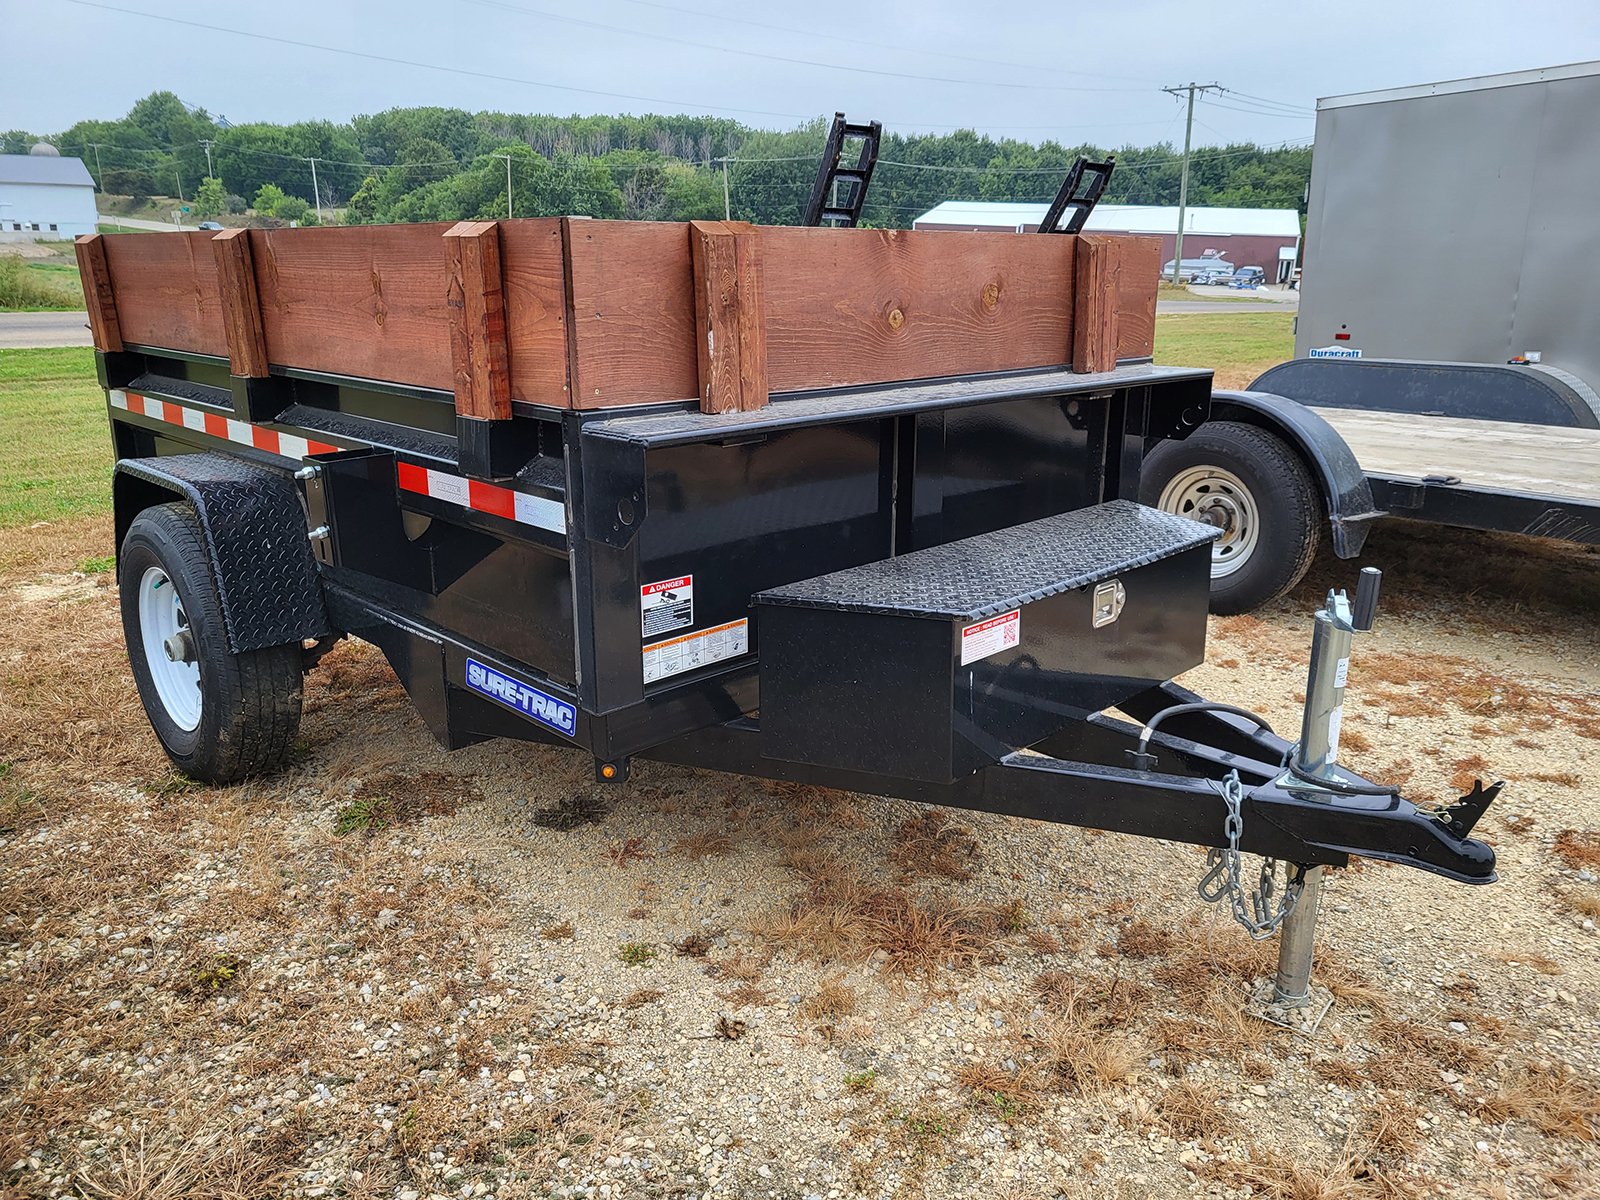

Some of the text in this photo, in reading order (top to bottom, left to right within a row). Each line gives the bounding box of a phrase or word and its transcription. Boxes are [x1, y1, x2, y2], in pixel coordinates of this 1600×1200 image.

[1310, 350, 1360, 358] Duracraft
[656, 579, 685, 591] DANGER
[468, 664, 573, 730] SURE-TRAC
